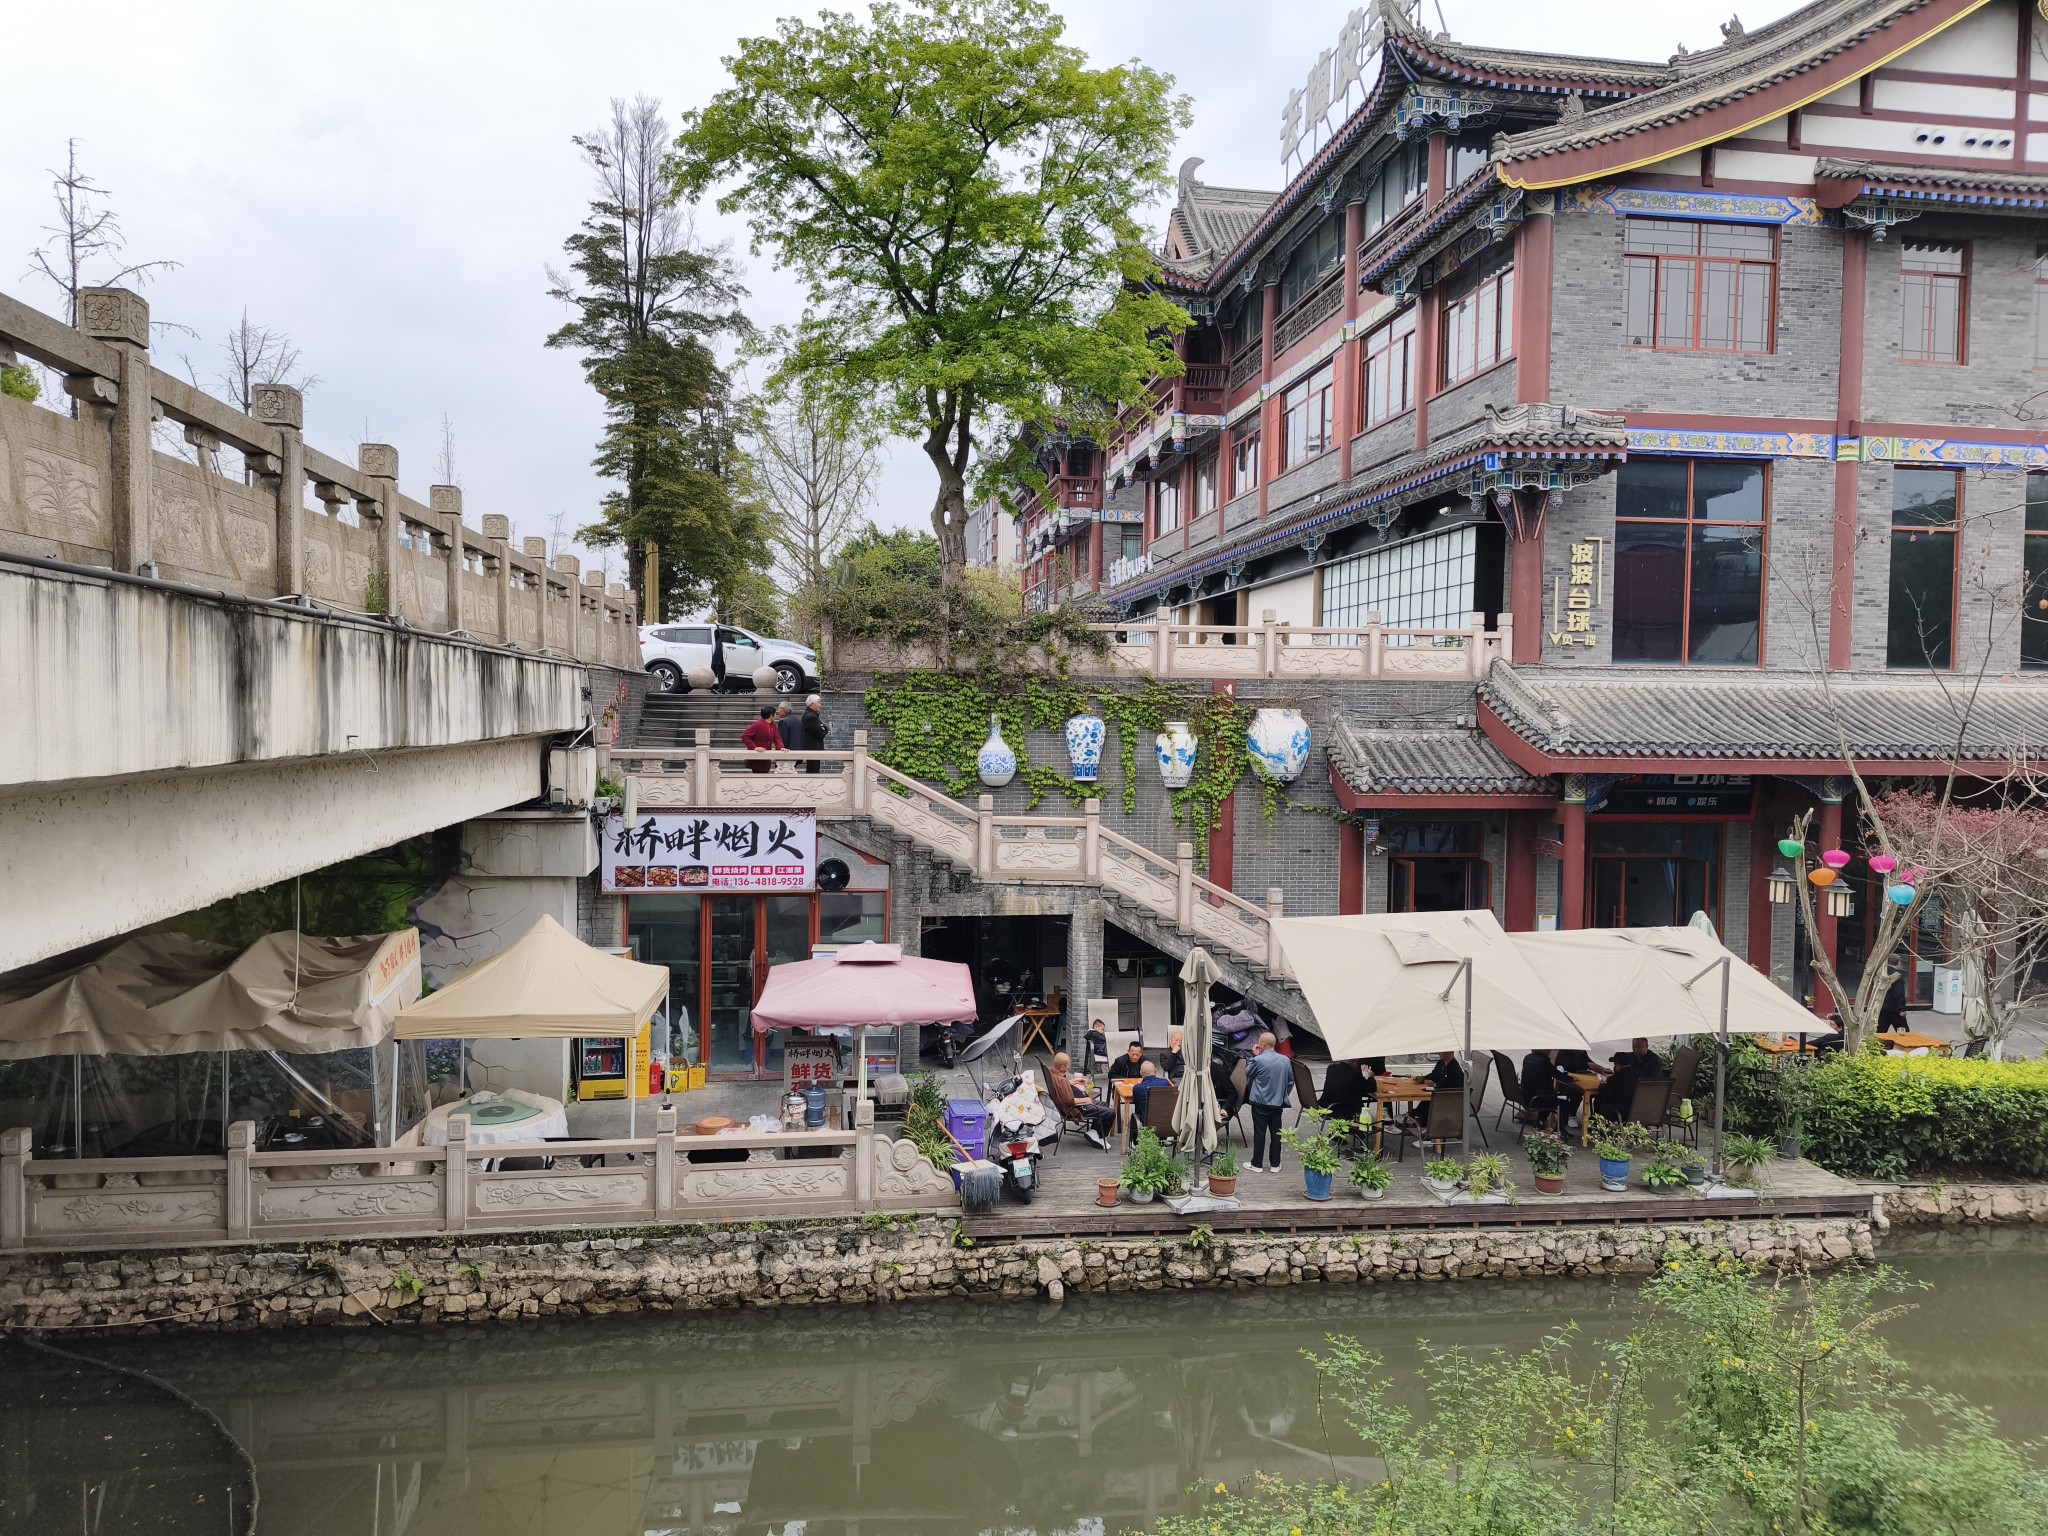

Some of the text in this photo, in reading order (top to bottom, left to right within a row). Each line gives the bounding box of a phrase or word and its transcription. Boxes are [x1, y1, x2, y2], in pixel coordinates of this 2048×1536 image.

[1567, 544, 1593, 632] 波波台球
[1562, 634, 1596, 646] 负一楼
[614, 817, 804, 861] 桥畔烟火
[788, 1049, 834, 1059] 桥畔烟火
[791, 1063, 831, 1079] 鲜货
